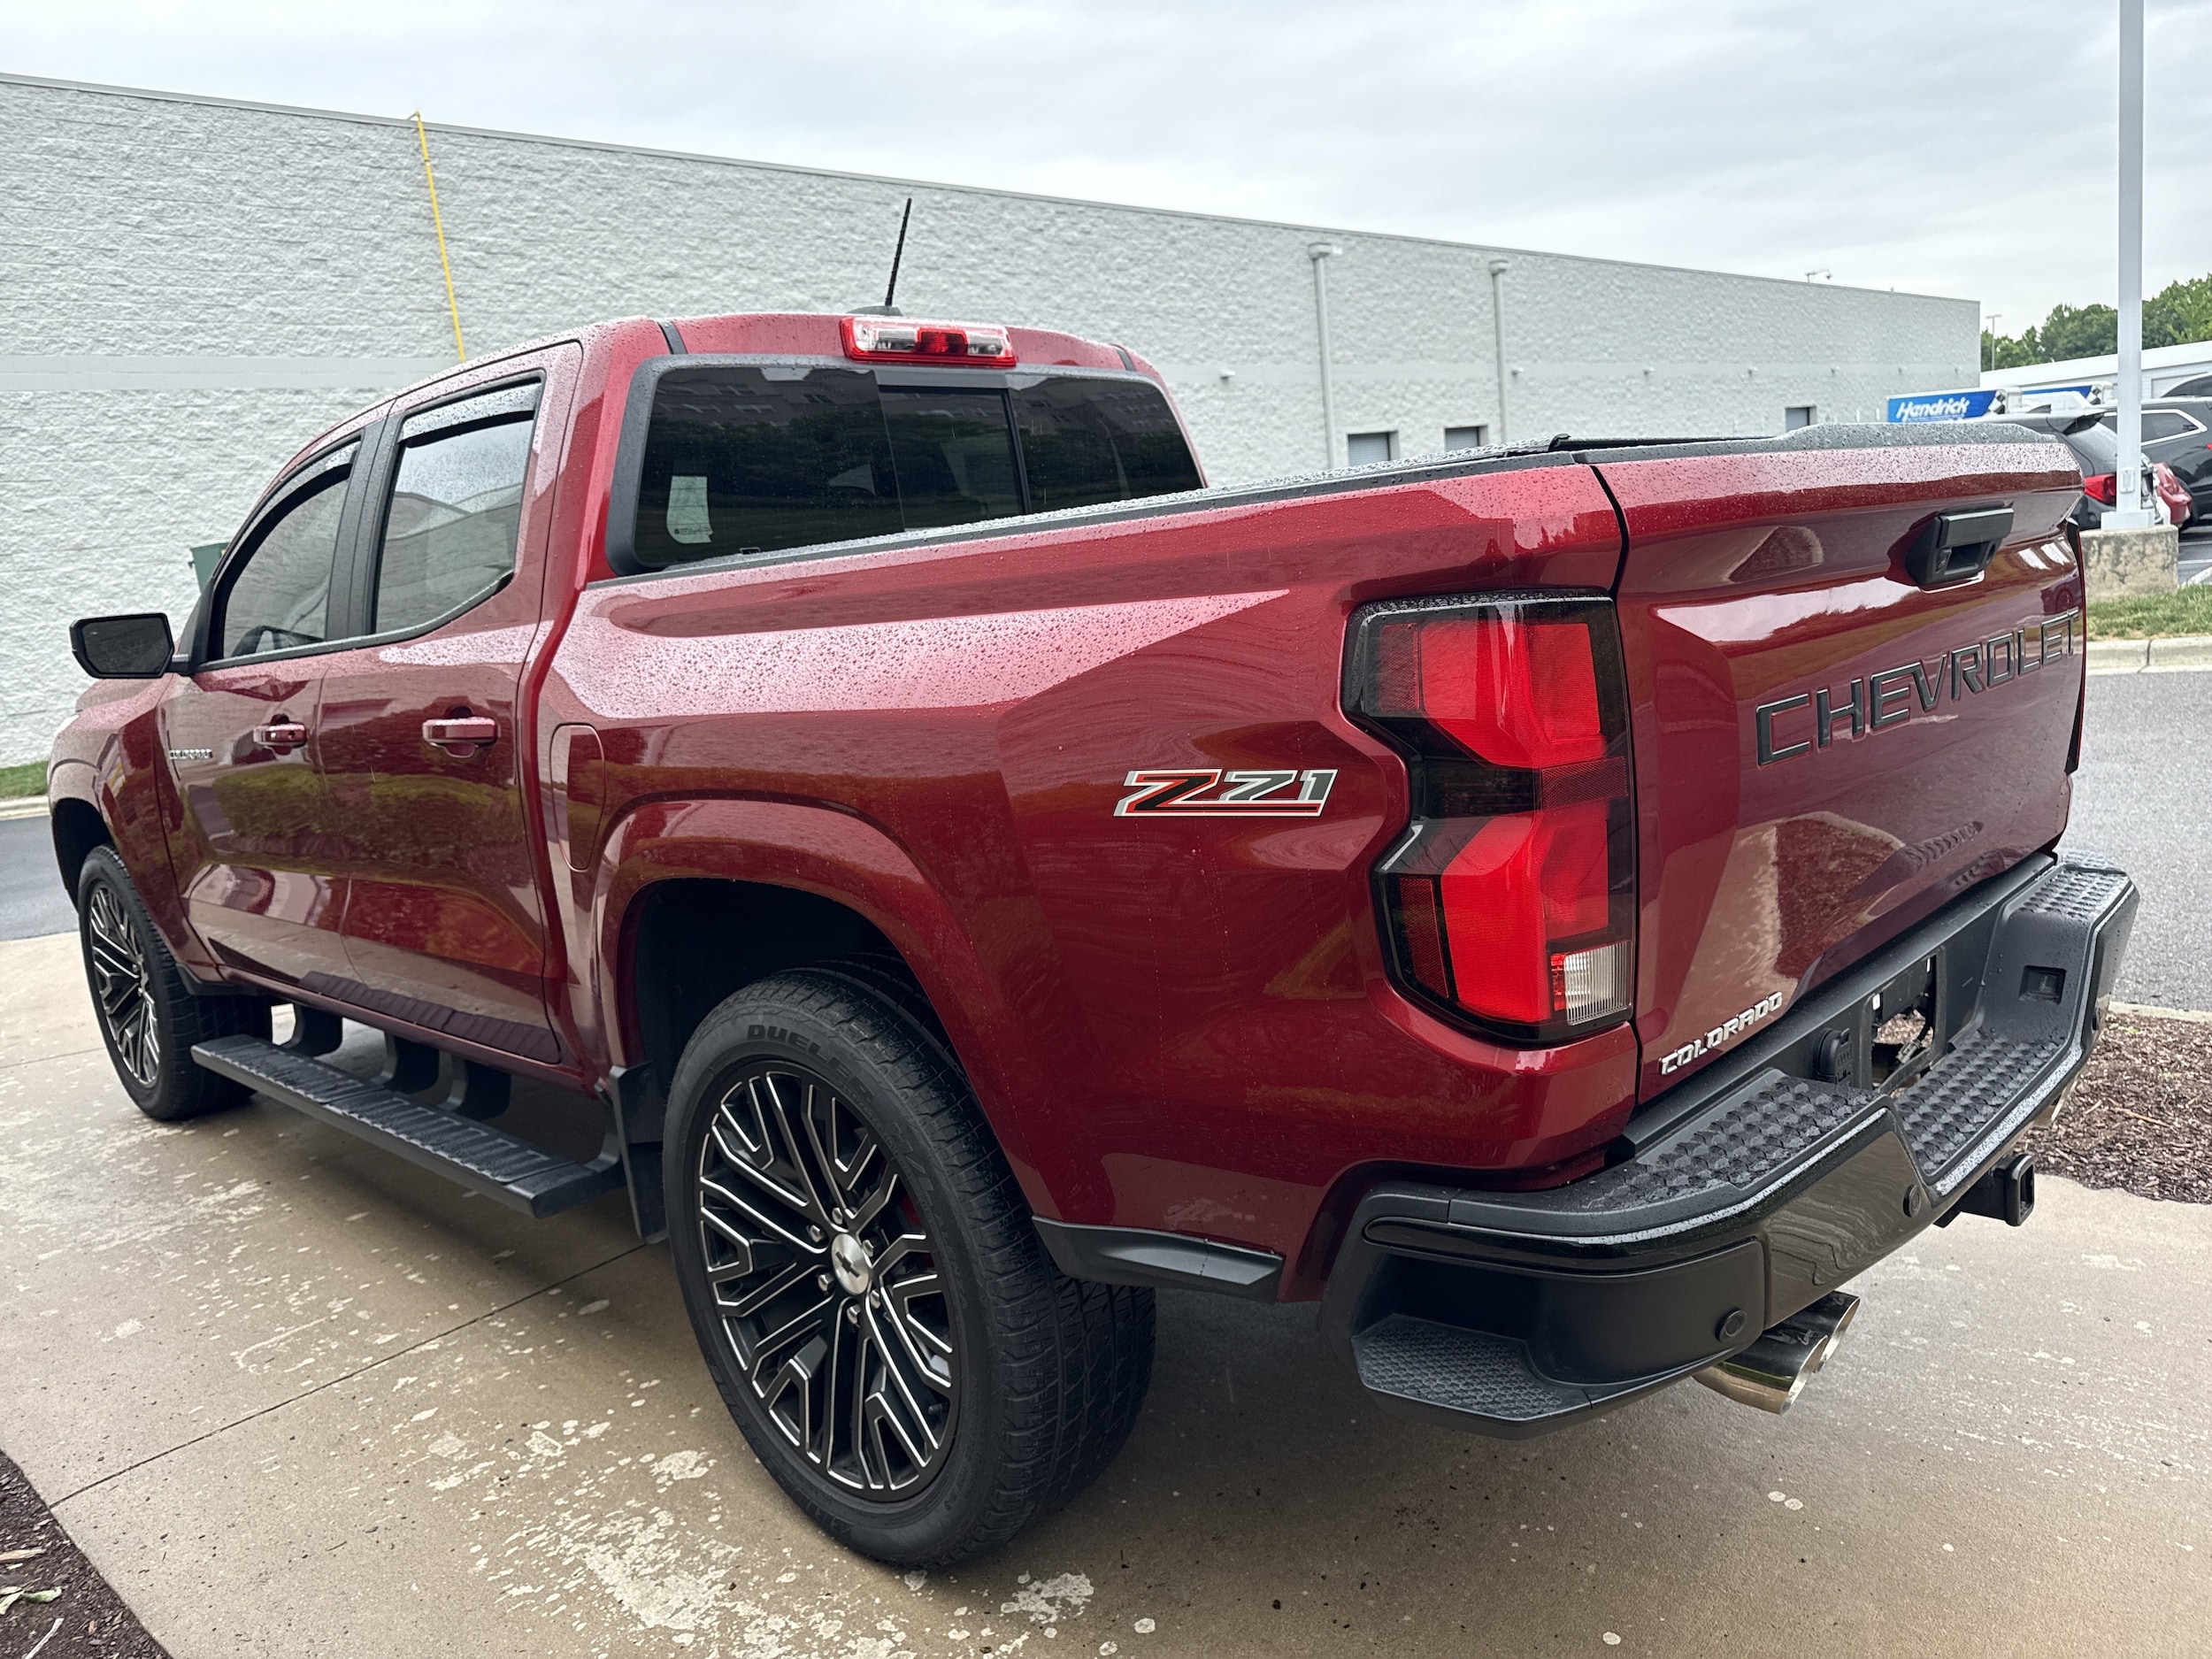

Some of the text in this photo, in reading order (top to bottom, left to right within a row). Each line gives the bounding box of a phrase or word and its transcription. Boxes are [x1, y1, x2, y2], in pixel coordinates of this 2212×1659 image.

[1895, 397, 1970, 420] Hendrick
[1756, 609, 2081, 767] CHEVROLET
[1113, 767, 1338, 818] Z71
[748, 1024, 875, 1102] DUELER
[1659, 991, 1784, 1076] COLORADO
